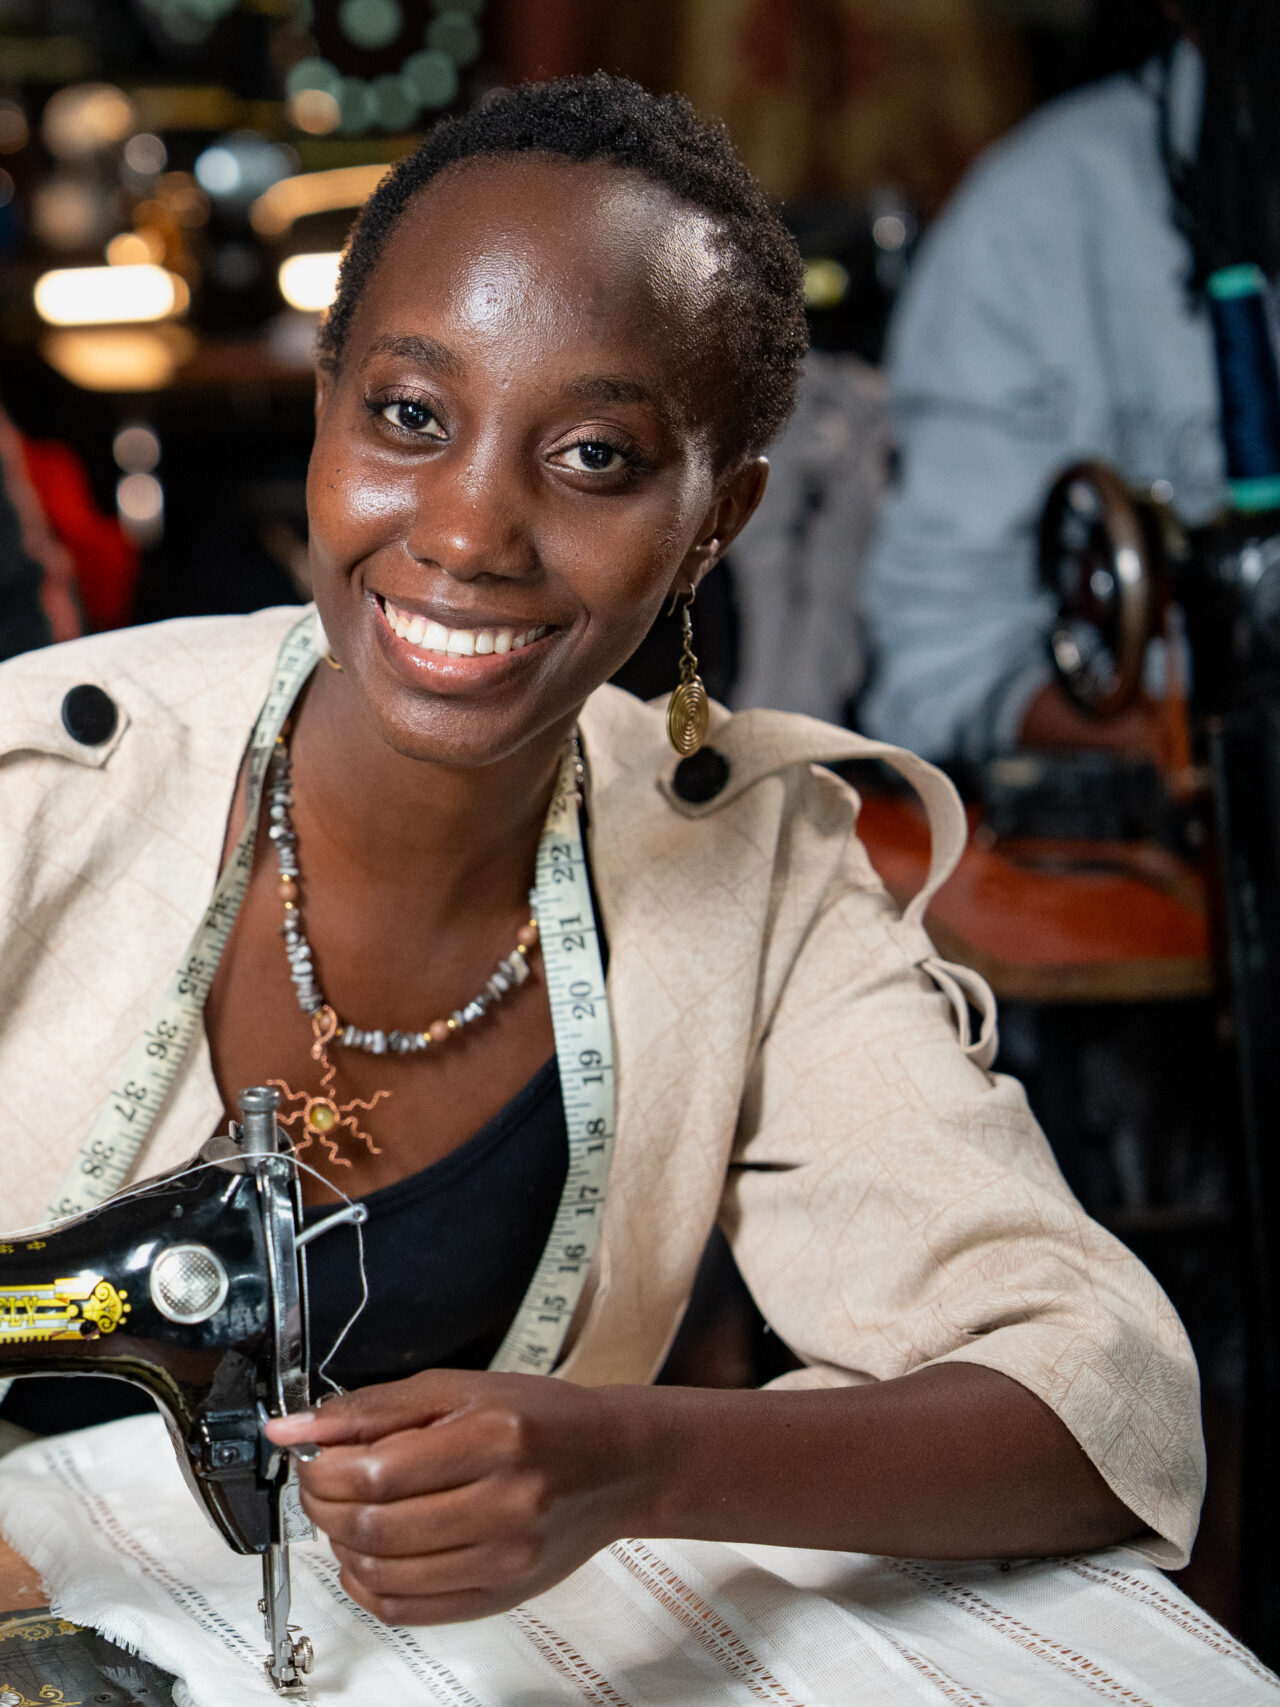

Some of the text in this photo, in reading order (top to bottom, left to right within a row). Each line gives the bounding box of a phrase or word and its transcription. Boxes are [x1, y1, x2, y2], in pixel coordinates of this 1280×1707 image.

[551, 843, 575, 884] 22
[559, 913, 586, 952] 21
[178, 957, 205, 996] 35
[569, 981, 596, 1020] 20
[146, 1020, 178, 1060] 36
[579, 1049, 604, 1088] 19
[114, 1081, 147, 1122] 37
[586, 1117, 607, 1155] 18
[81, 1140, 114, 1179] 38
[575, 1184, 599, 1217] 17
[558, 1244, 586, 1273] 16
[538, 1294, 567, 1324] 15
